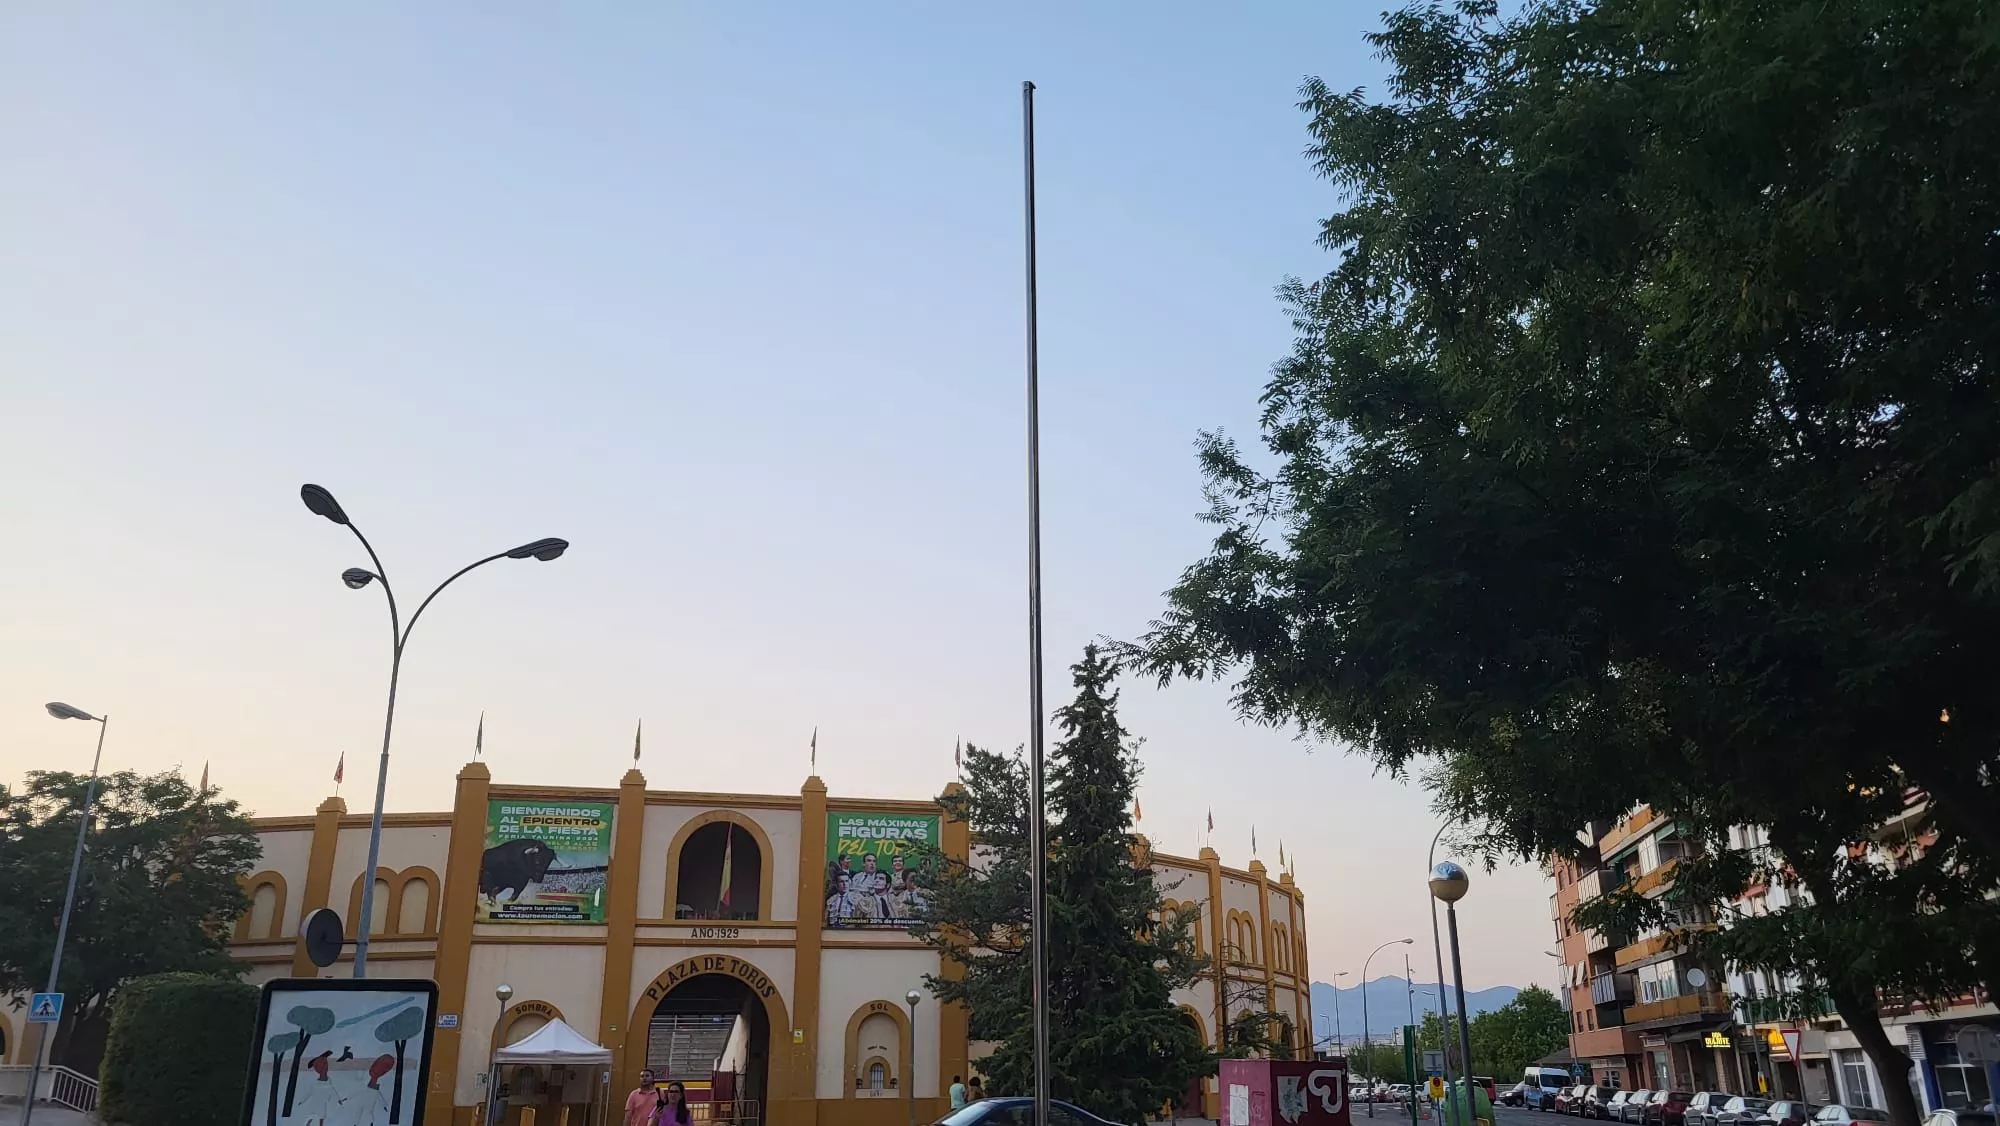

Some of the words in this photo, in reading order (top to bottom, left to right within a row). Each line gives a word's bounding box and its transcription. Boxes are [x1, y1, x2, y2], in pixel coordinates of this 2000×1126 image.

[501, 806, 601, 817] BIENVENIDOS
[500, 816, 518, 824] AL
[523, 816, 600, 826] EPICENTRO
[839, 818, 865, 826] LAS
[868, 817, 928, 828] MÁXIMAS
[499, 825, 519, 833] DE
[523, 825, 543, 834] LA
[548, 826, 598, 836] FIESTA
[838, 826, 928, 840] FIGURAS
[838, 837, 868, 856] DEL
[647, 960, 699, 1001] PLAZA
[703, 956, 726, 971] DE
[730, 959, 775, 998] TOROS
[515, 1003, 553, 1016] SOMBRA
[870, 1003, 888, 1011] SOL
